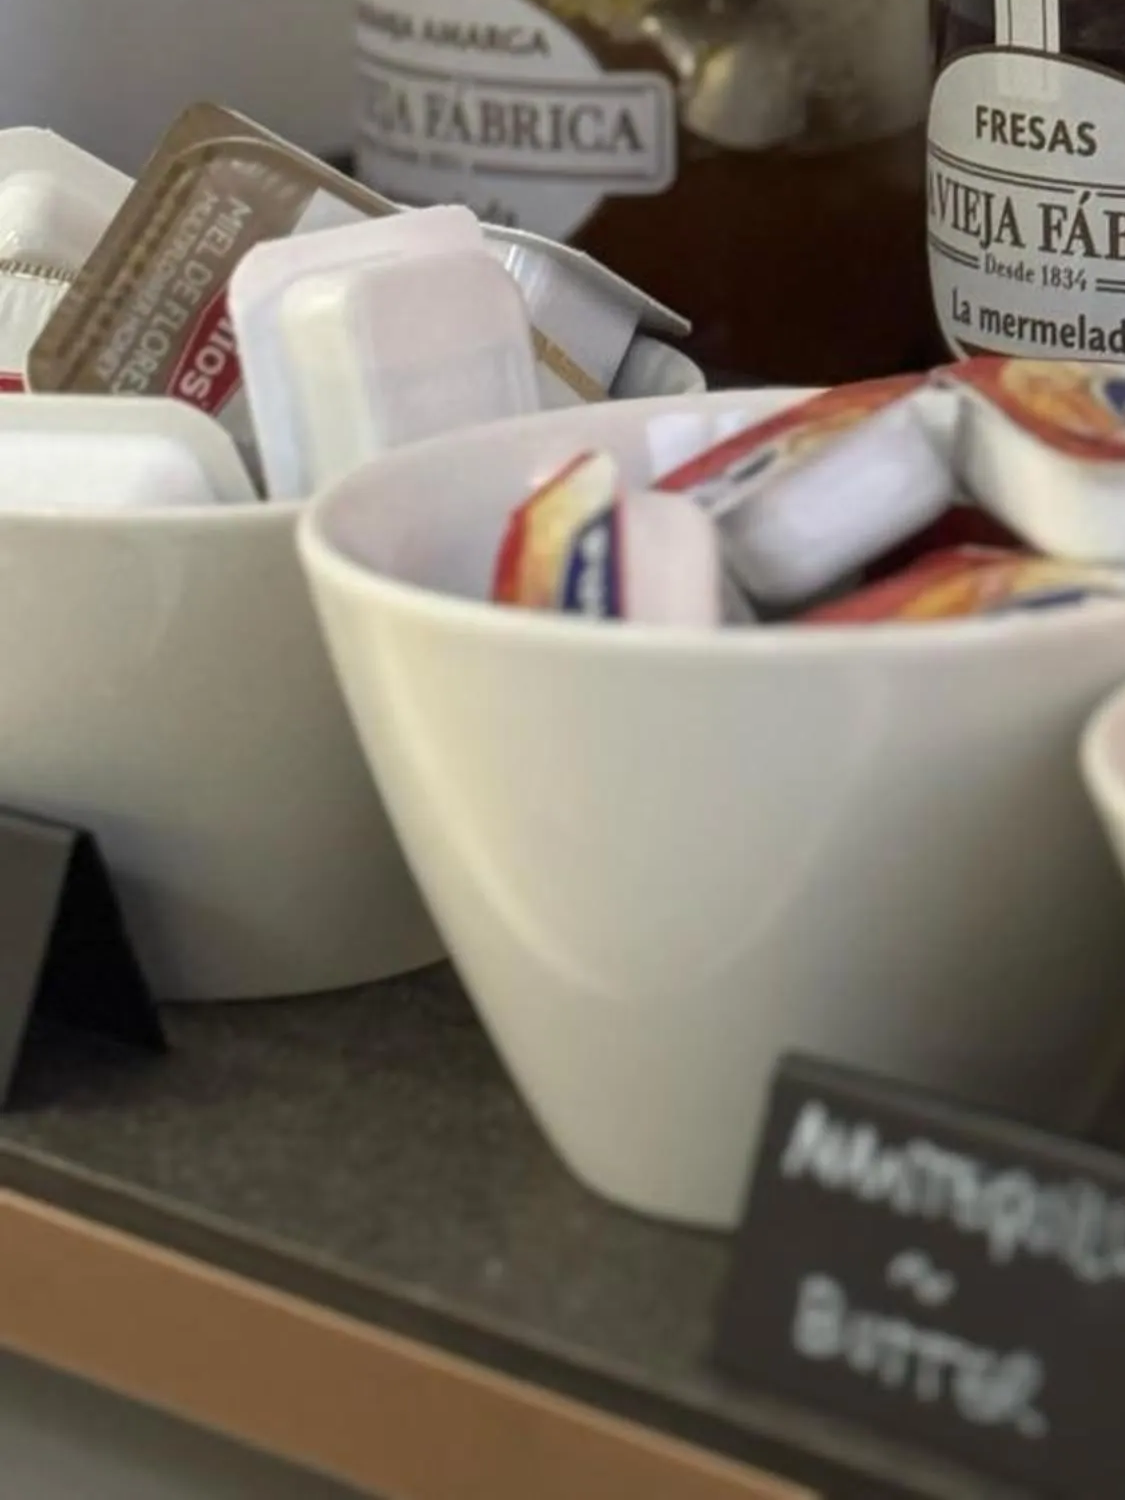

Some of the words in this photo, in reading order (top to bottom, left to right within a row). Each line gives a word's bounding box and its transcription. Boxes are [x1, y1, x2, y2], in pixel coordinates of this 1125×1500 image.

[424, 83, 646, 155] FÁBRICA
[975, 104, 1098, 157] FRESAS
[195, 195, 254, 258] MIEL
[936, 171, 1027, 250] VIEJA
[172, 259, 214, 306] DE
[984, 252, 1036, 284] Desde
[1041, 265, 1088, 292] 1834
[951, 288, 972, 326] La
